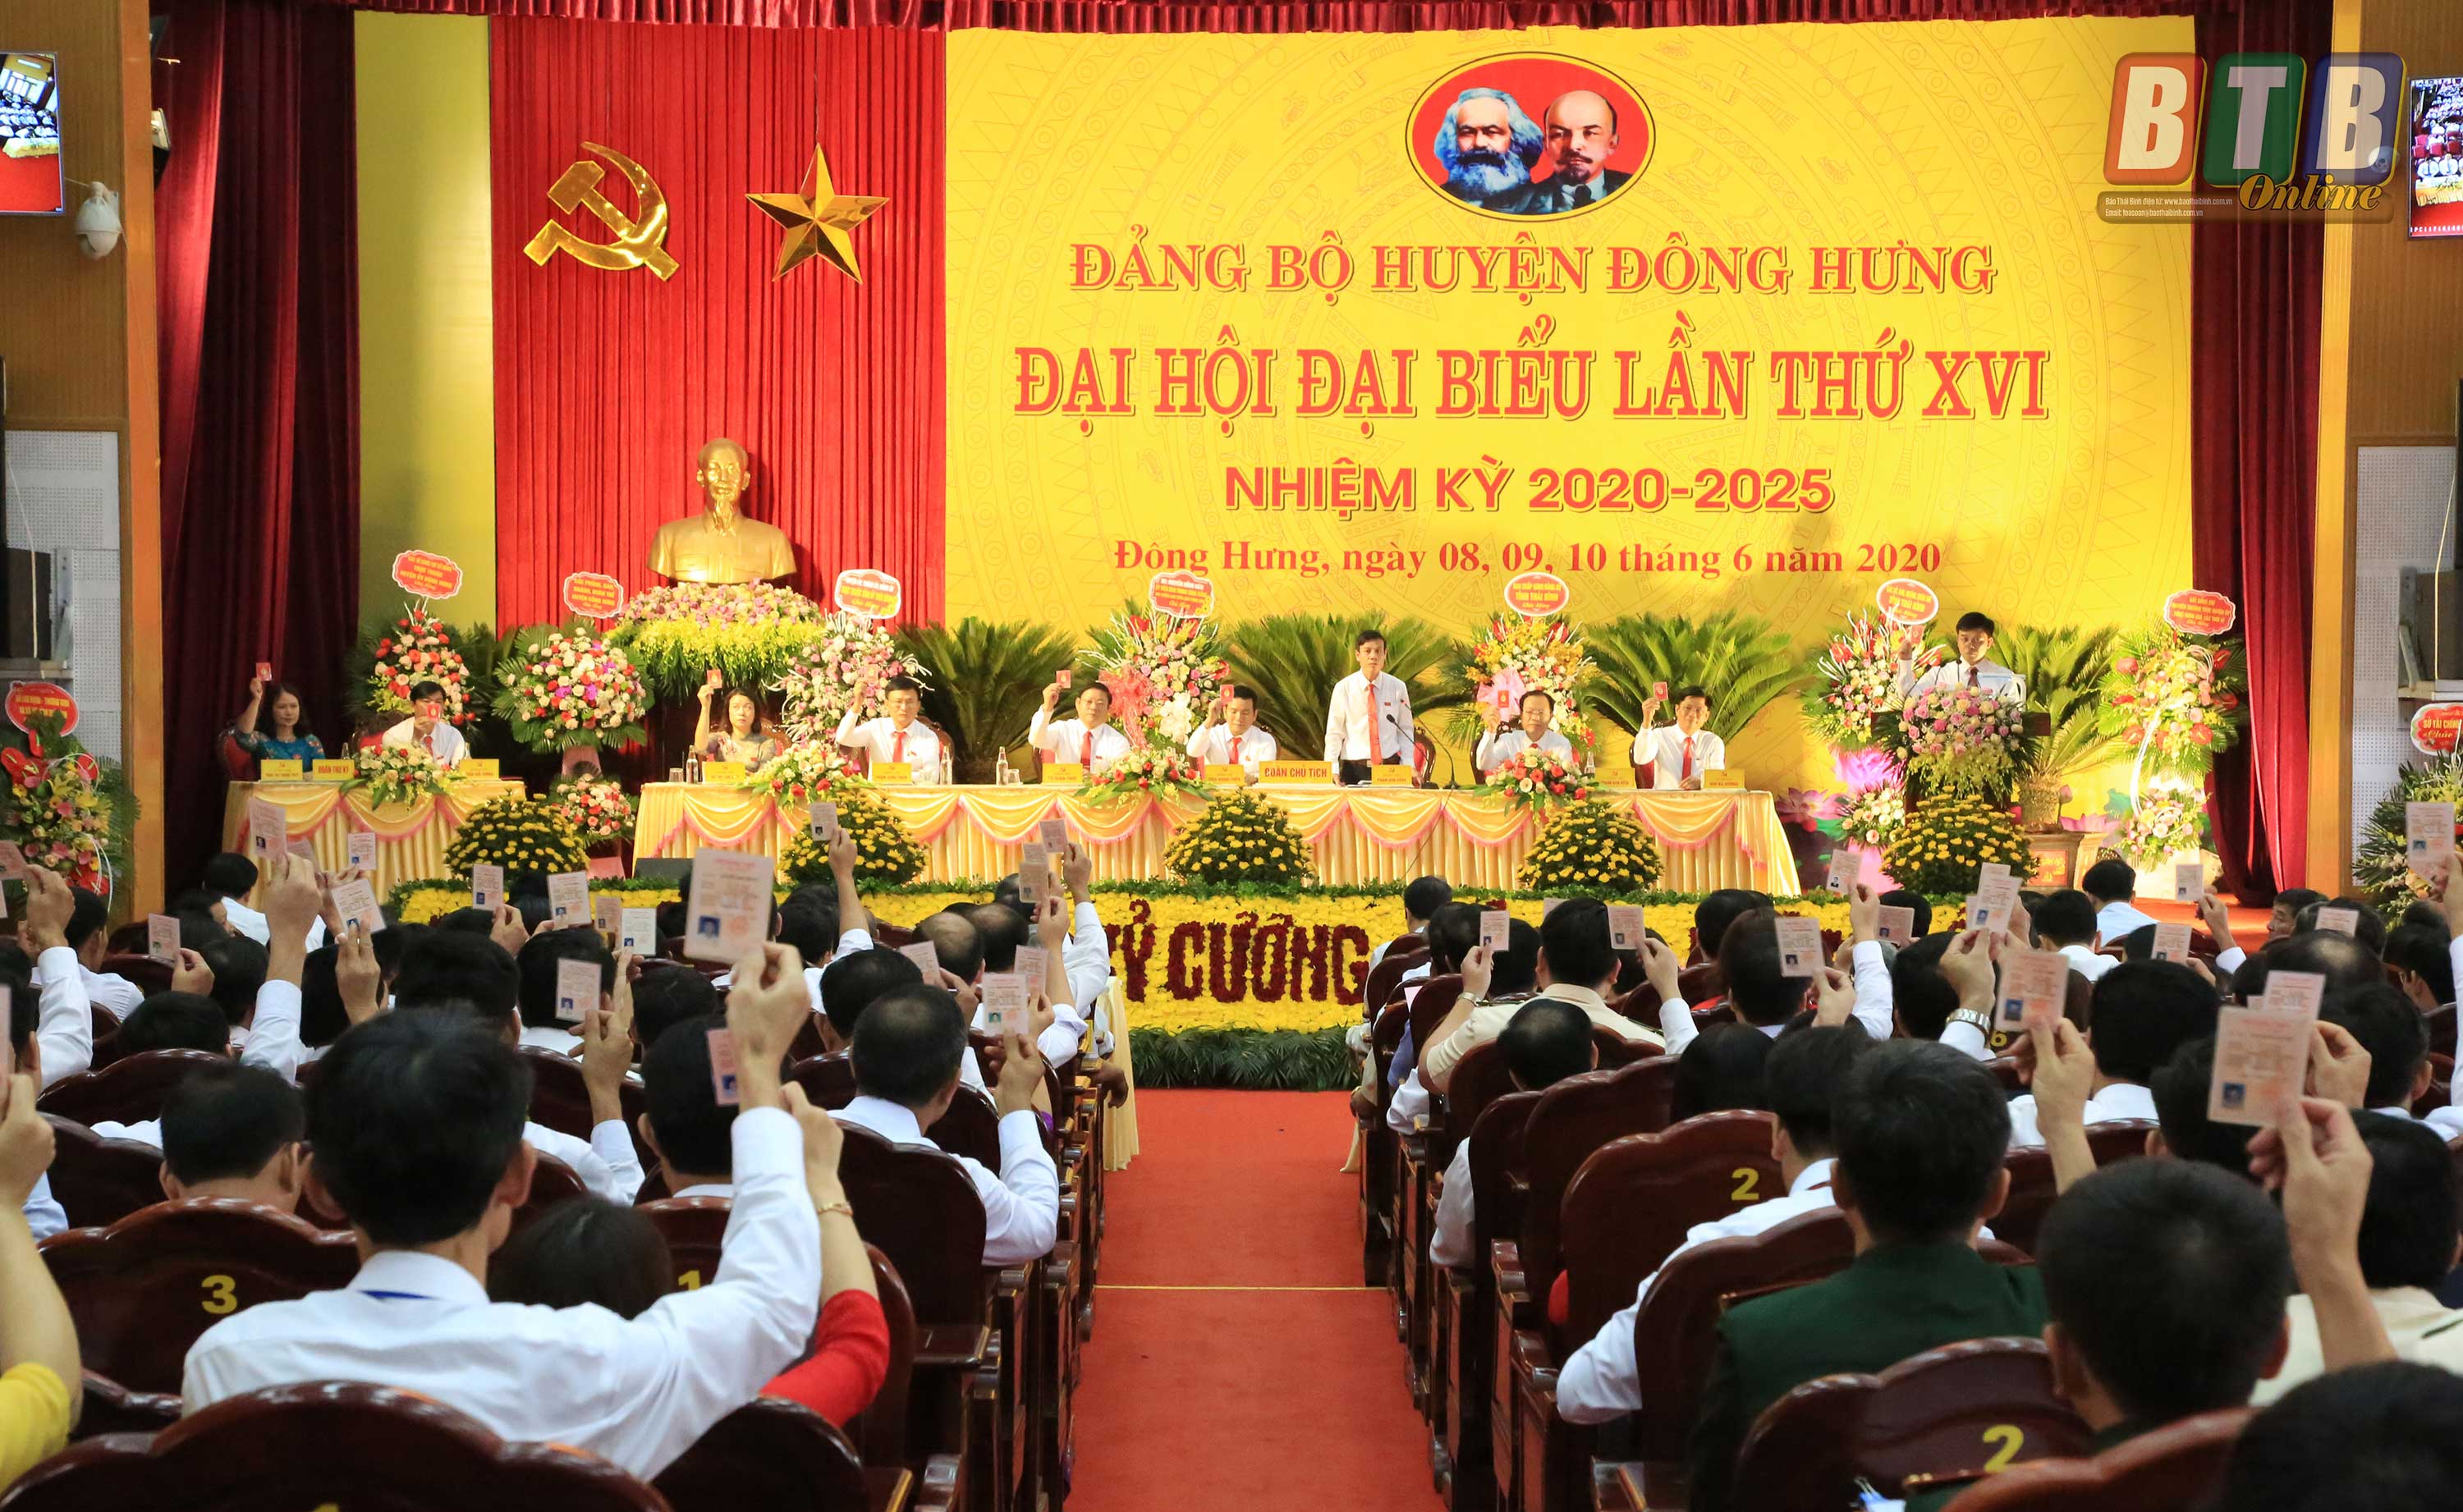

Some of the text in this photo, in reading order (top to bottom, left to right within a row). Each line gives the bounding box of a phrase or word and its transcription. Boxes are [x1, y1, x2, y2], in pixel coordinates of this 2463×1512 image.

[1070, 223, 1996, 304] ĐẢNG BỘ HUYỆN ĐÔNG HƯNG
[1013, 309, 2048, 436] ĐẠI HỘI ĐẠI BIỂU LẦN THỨ XVI
[1225, 453, 1834, 519] NHIỆM KỲ 2020-2025
[1114, 539, 1942, 580] Đông Hưng, ngày 08, 09, 10 tháng 6 năm 2020
[1105, 899, 1369, 1005] Ỷ CƯƠNG
[1731, 1167, 1759, 1201] 2
[201, 1274, 238, 1314] 3
[1982, 1423, 2025, 1473] 2
